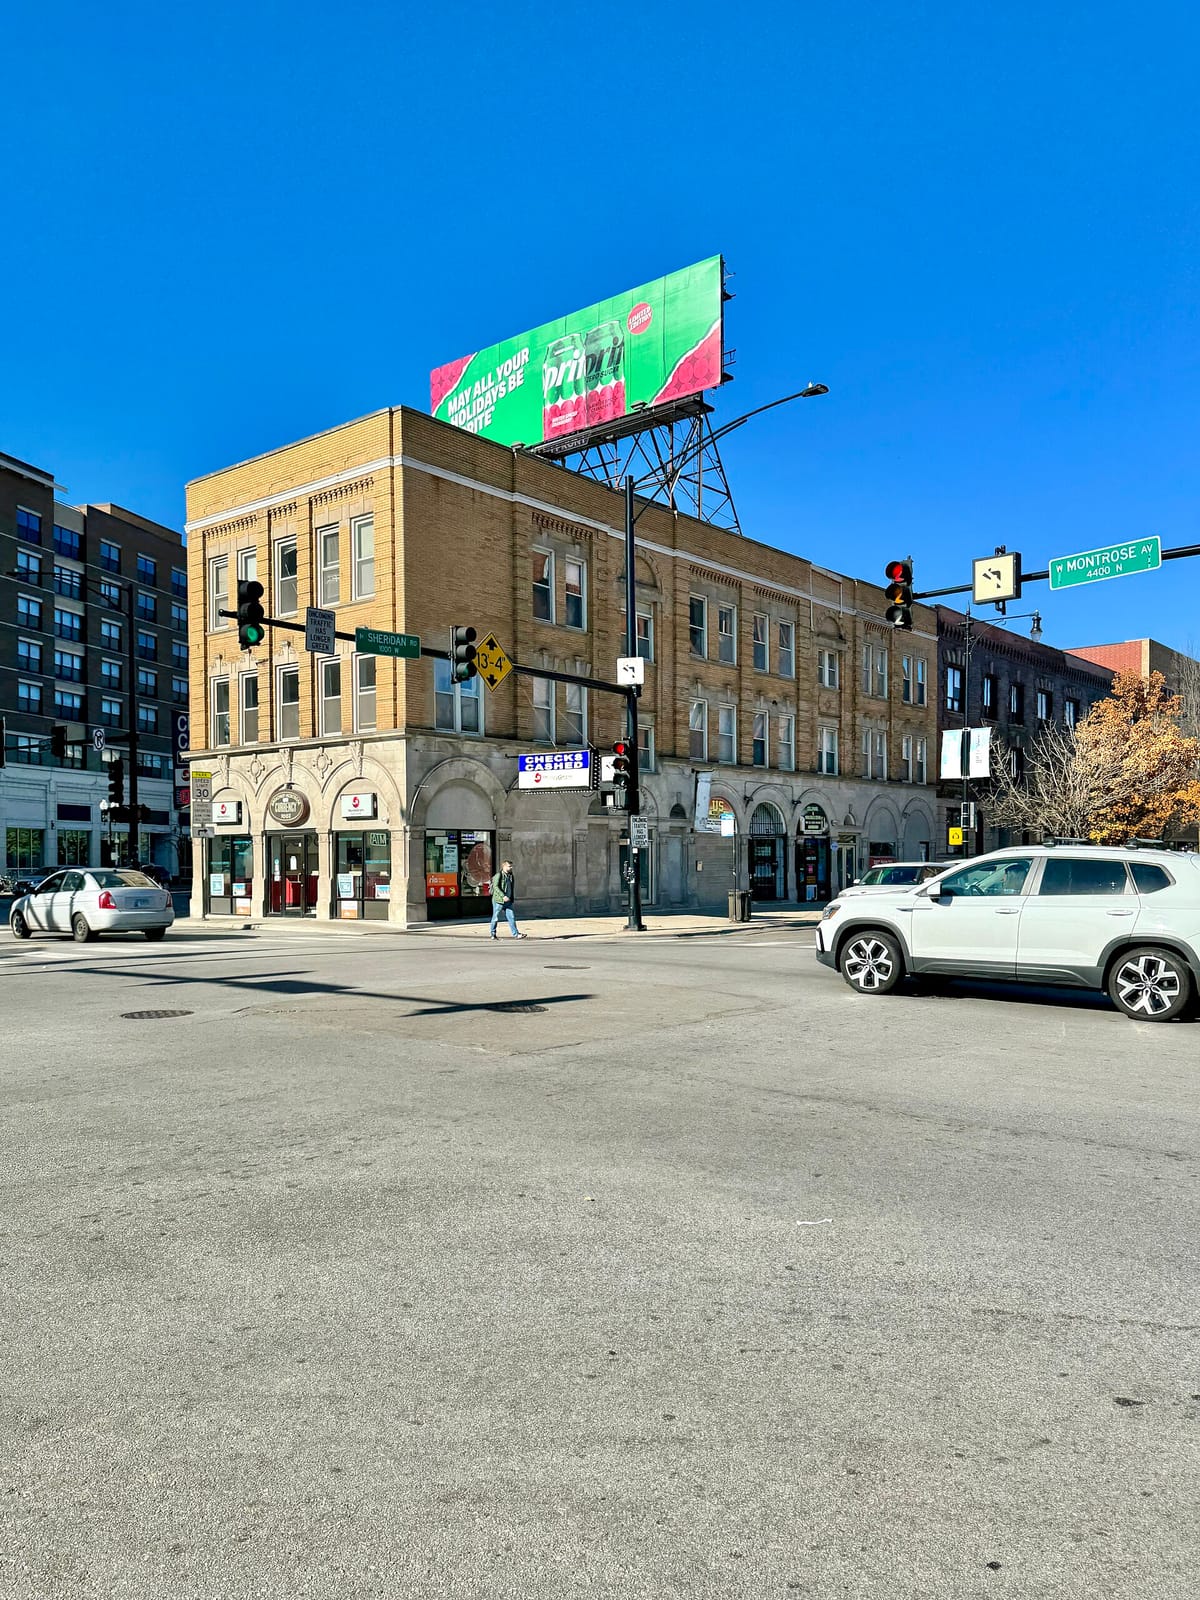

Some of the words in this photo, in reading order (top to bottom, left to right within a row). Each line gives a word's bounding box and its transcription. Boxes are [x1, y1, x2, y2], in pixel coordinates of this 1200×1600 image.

[447, 386, 472, 418] MAY
[473, 372, 495, 401] ALL
[496, 347, 529, 383] YOUR
[450, 381, 507, 427] HOLIDAYS
[508, 367, 525, 394] BE
[1056, 564, 1063, 573] W
[1066, 546, 1137, 572] MONTROSE
[1141, 544, 1153, 554] AV
[1086, 566, 1111, 578] 4400
[1116, 563, 1123, 573] N
[310, 618, 333, 628] TRAFFIC
[315, 627, 327, 635] HAS
[310, 634, 331, 644] LONGER
[368, 633, 407, 647] SHERIDAN
[311, 641, 330, 650] GREEN
[525, 753, 583, 764] CHECKS
[525, 761, 583, 771] CASHED
[196, 788, 209, 797] 30
[371, 834, 386, 846] ATM
